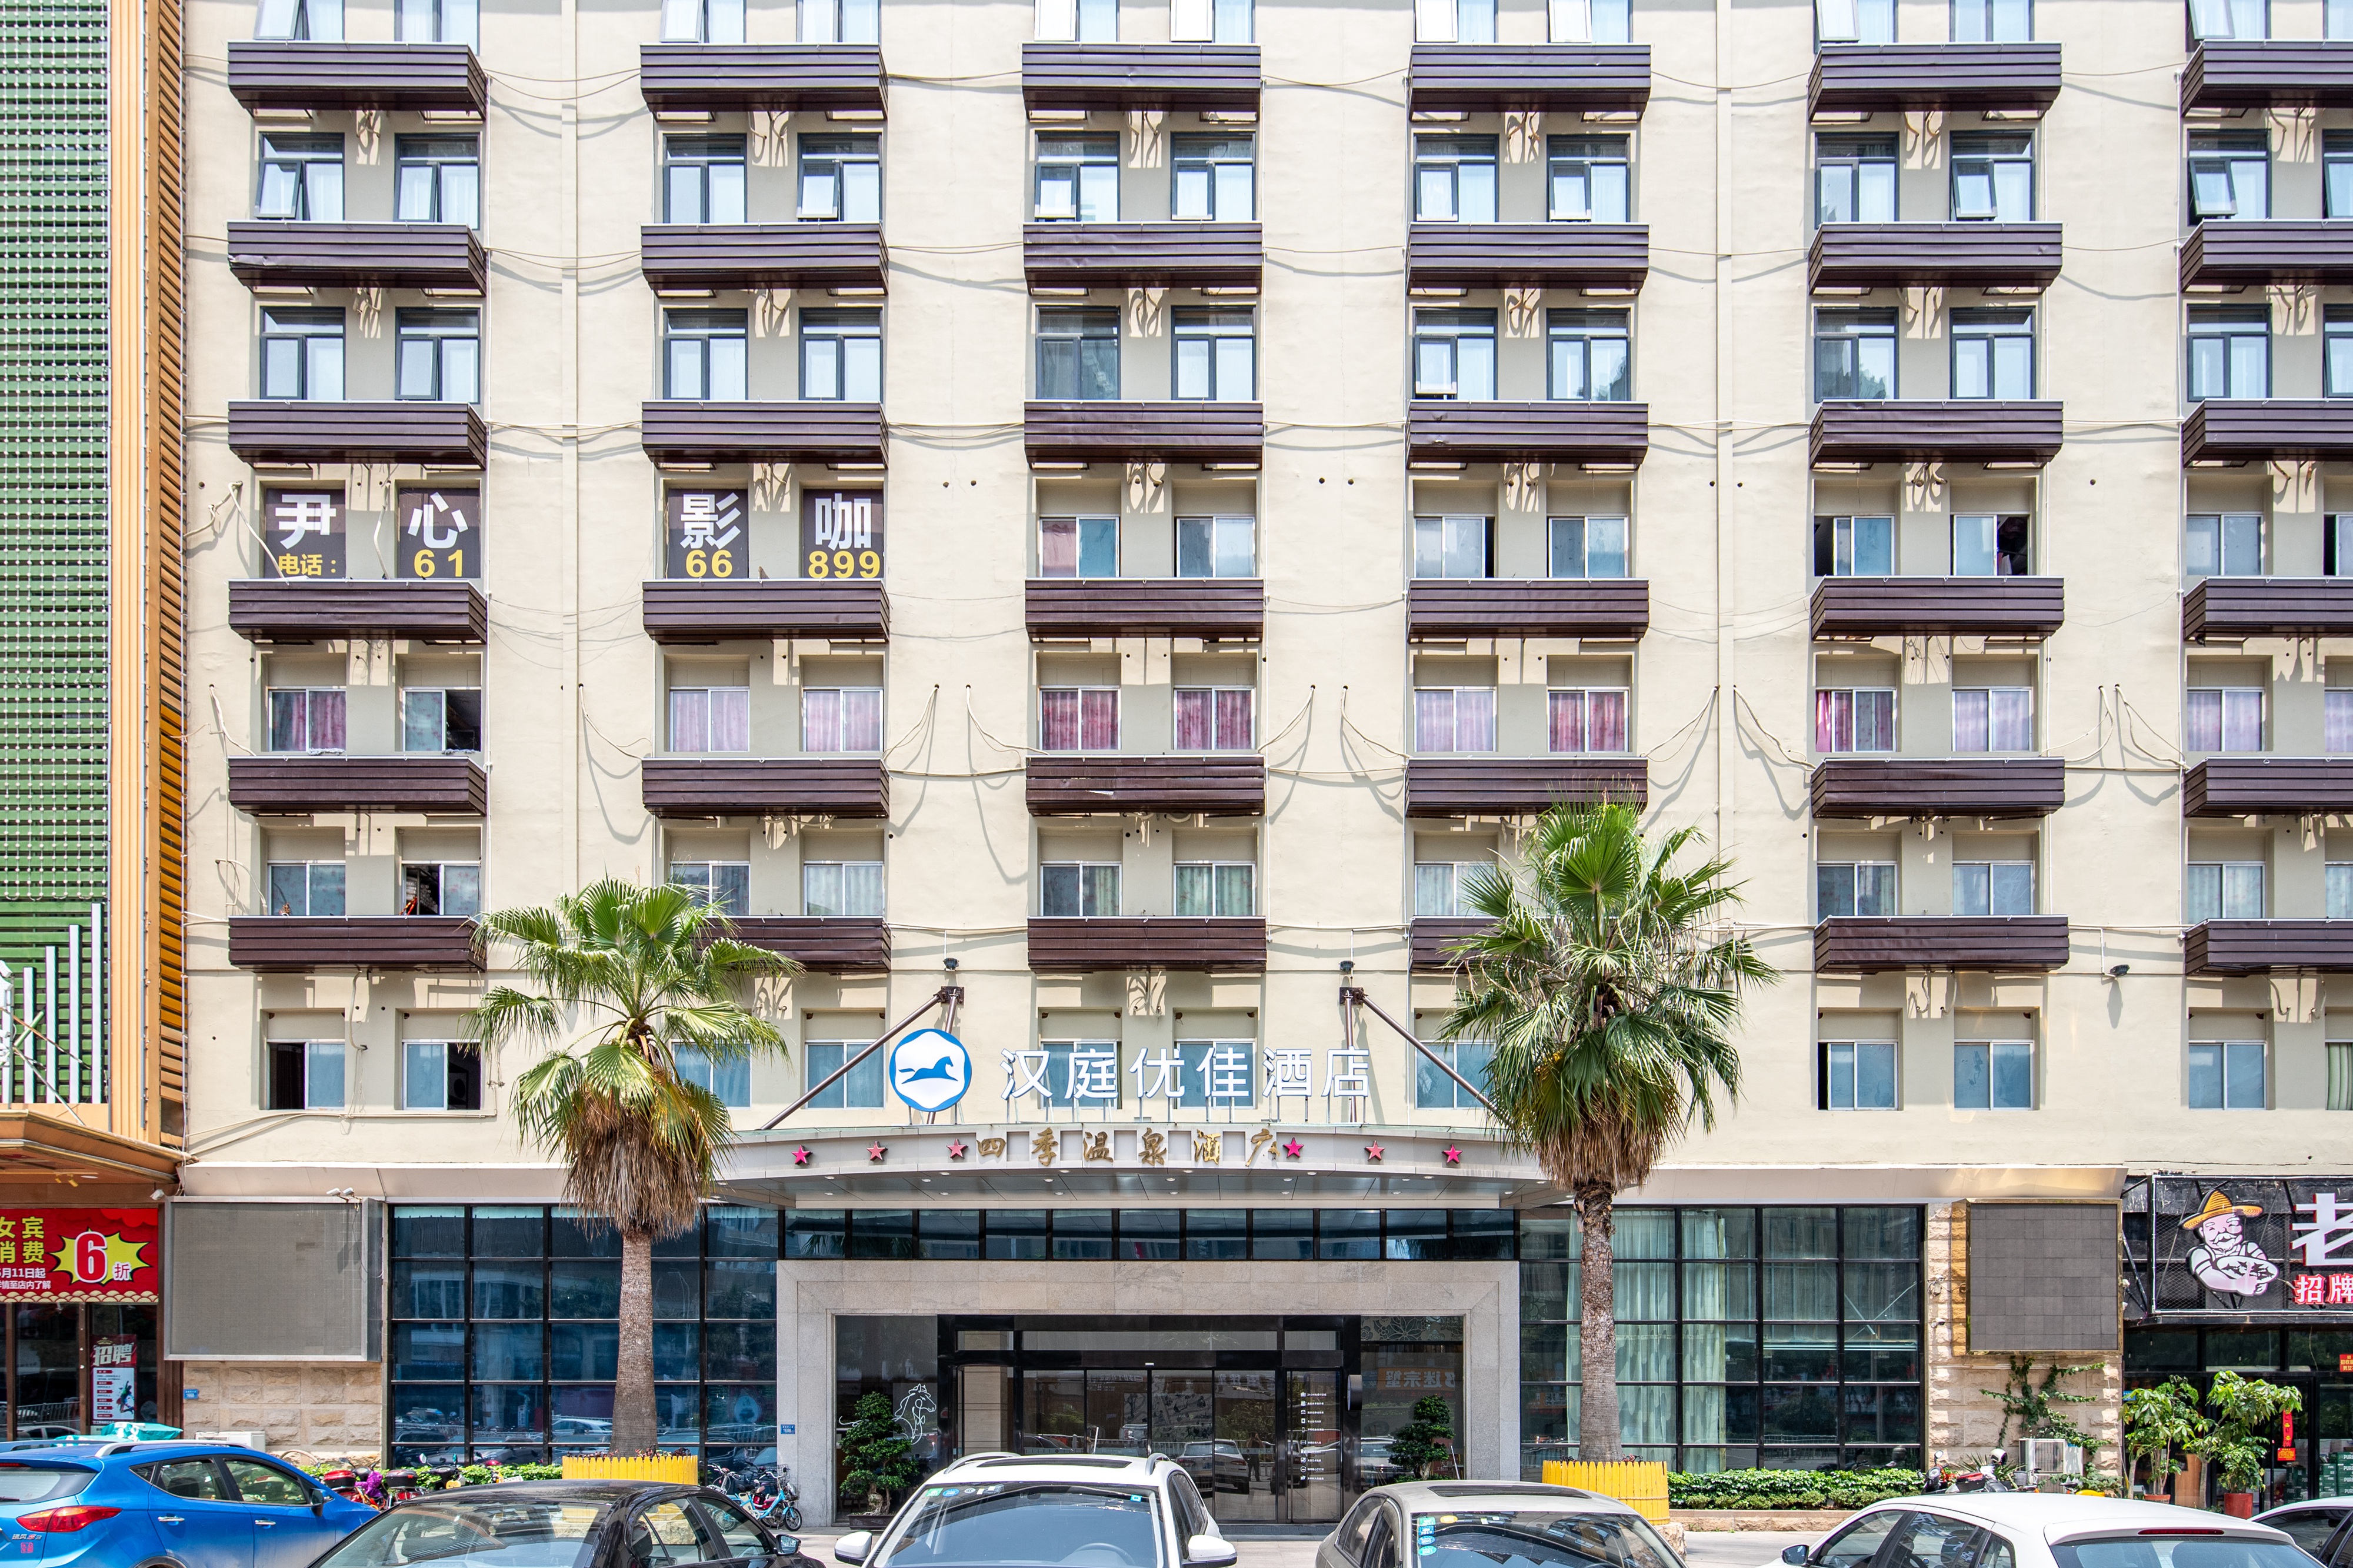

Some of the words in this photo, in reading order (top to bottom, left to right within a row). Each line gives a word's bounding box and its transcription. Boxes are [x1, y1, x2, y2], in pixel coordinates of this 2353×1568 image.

[275, 494, 336, 549] 尹
[408, 492, 468, 549] 心
[680, 492, 741, 550] 影
[815, 493, 871, 551] 咖
[685, 549, 733, 578] 66
[808, 551, 881, 579] 899
[1000, 1047, 1369, 1100] 汉庭优佳酒店
[0, 1216, 44, 1239] 女宾
[2289, 1192, 2353, 1267] 老
[0, 1240, 45, 1264] 消费
[0, 1267, 46, 1279] 月11日起
[0, 1280, 51, 1290] 情至店内了解
[93, 1342, 135, 1366] 招聘
